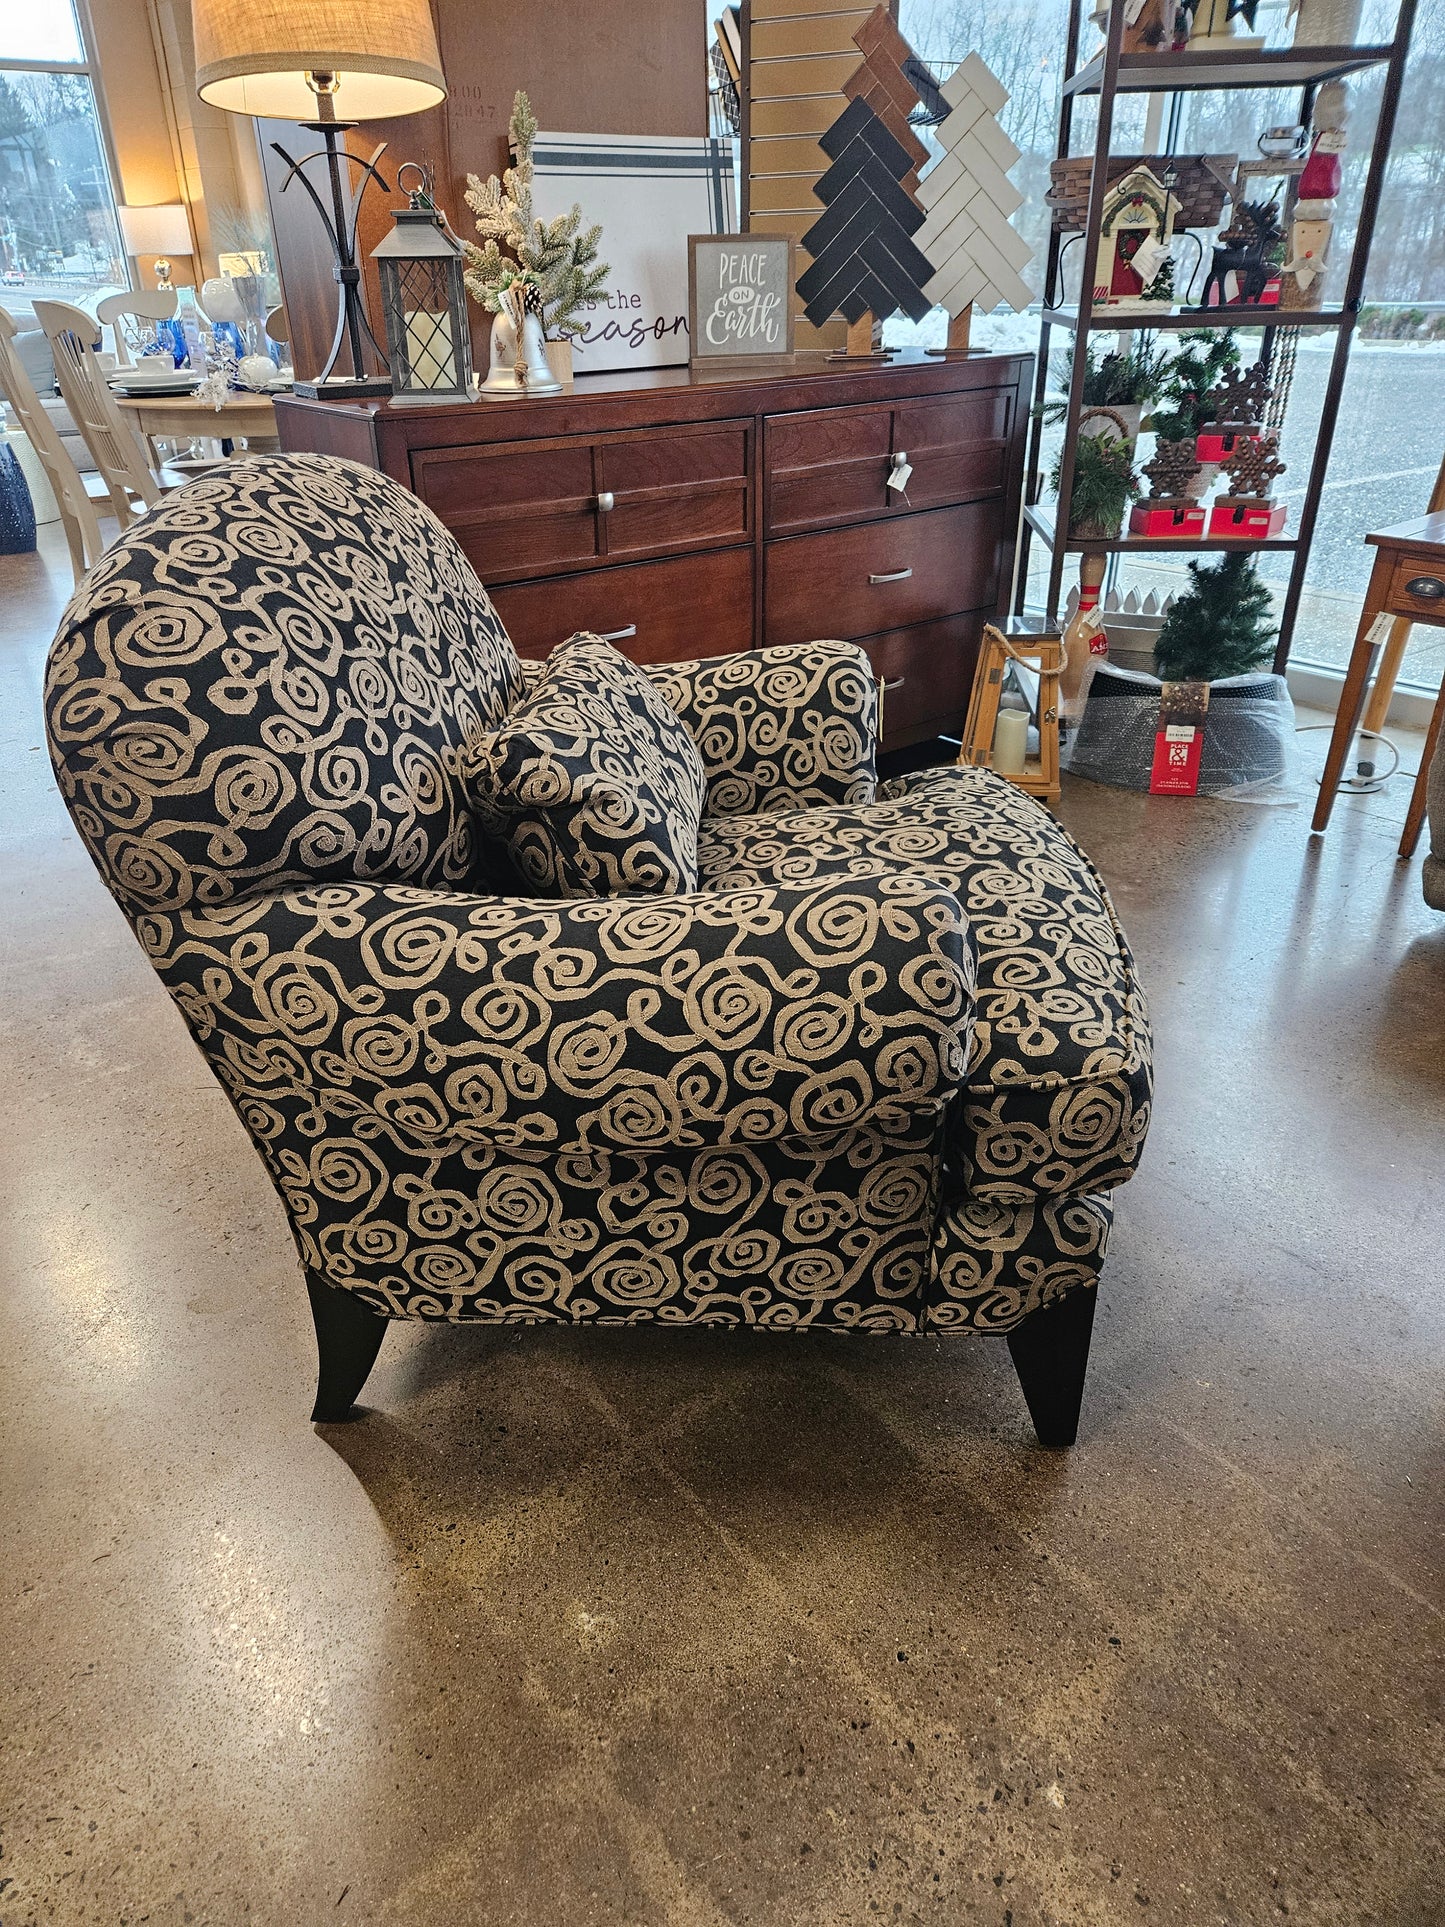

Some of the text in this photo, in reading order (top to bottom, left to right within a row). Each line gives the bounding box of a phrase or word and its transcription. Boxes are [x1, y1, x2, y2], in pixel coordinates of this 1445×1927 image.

[719, 252, 768, 289] PEACE
[607, 289, 642, 310] the
[733, 289, 750, 301] ON
[706, 291, 782, 345] Earth
[1170, 748, 1188, 763] &
